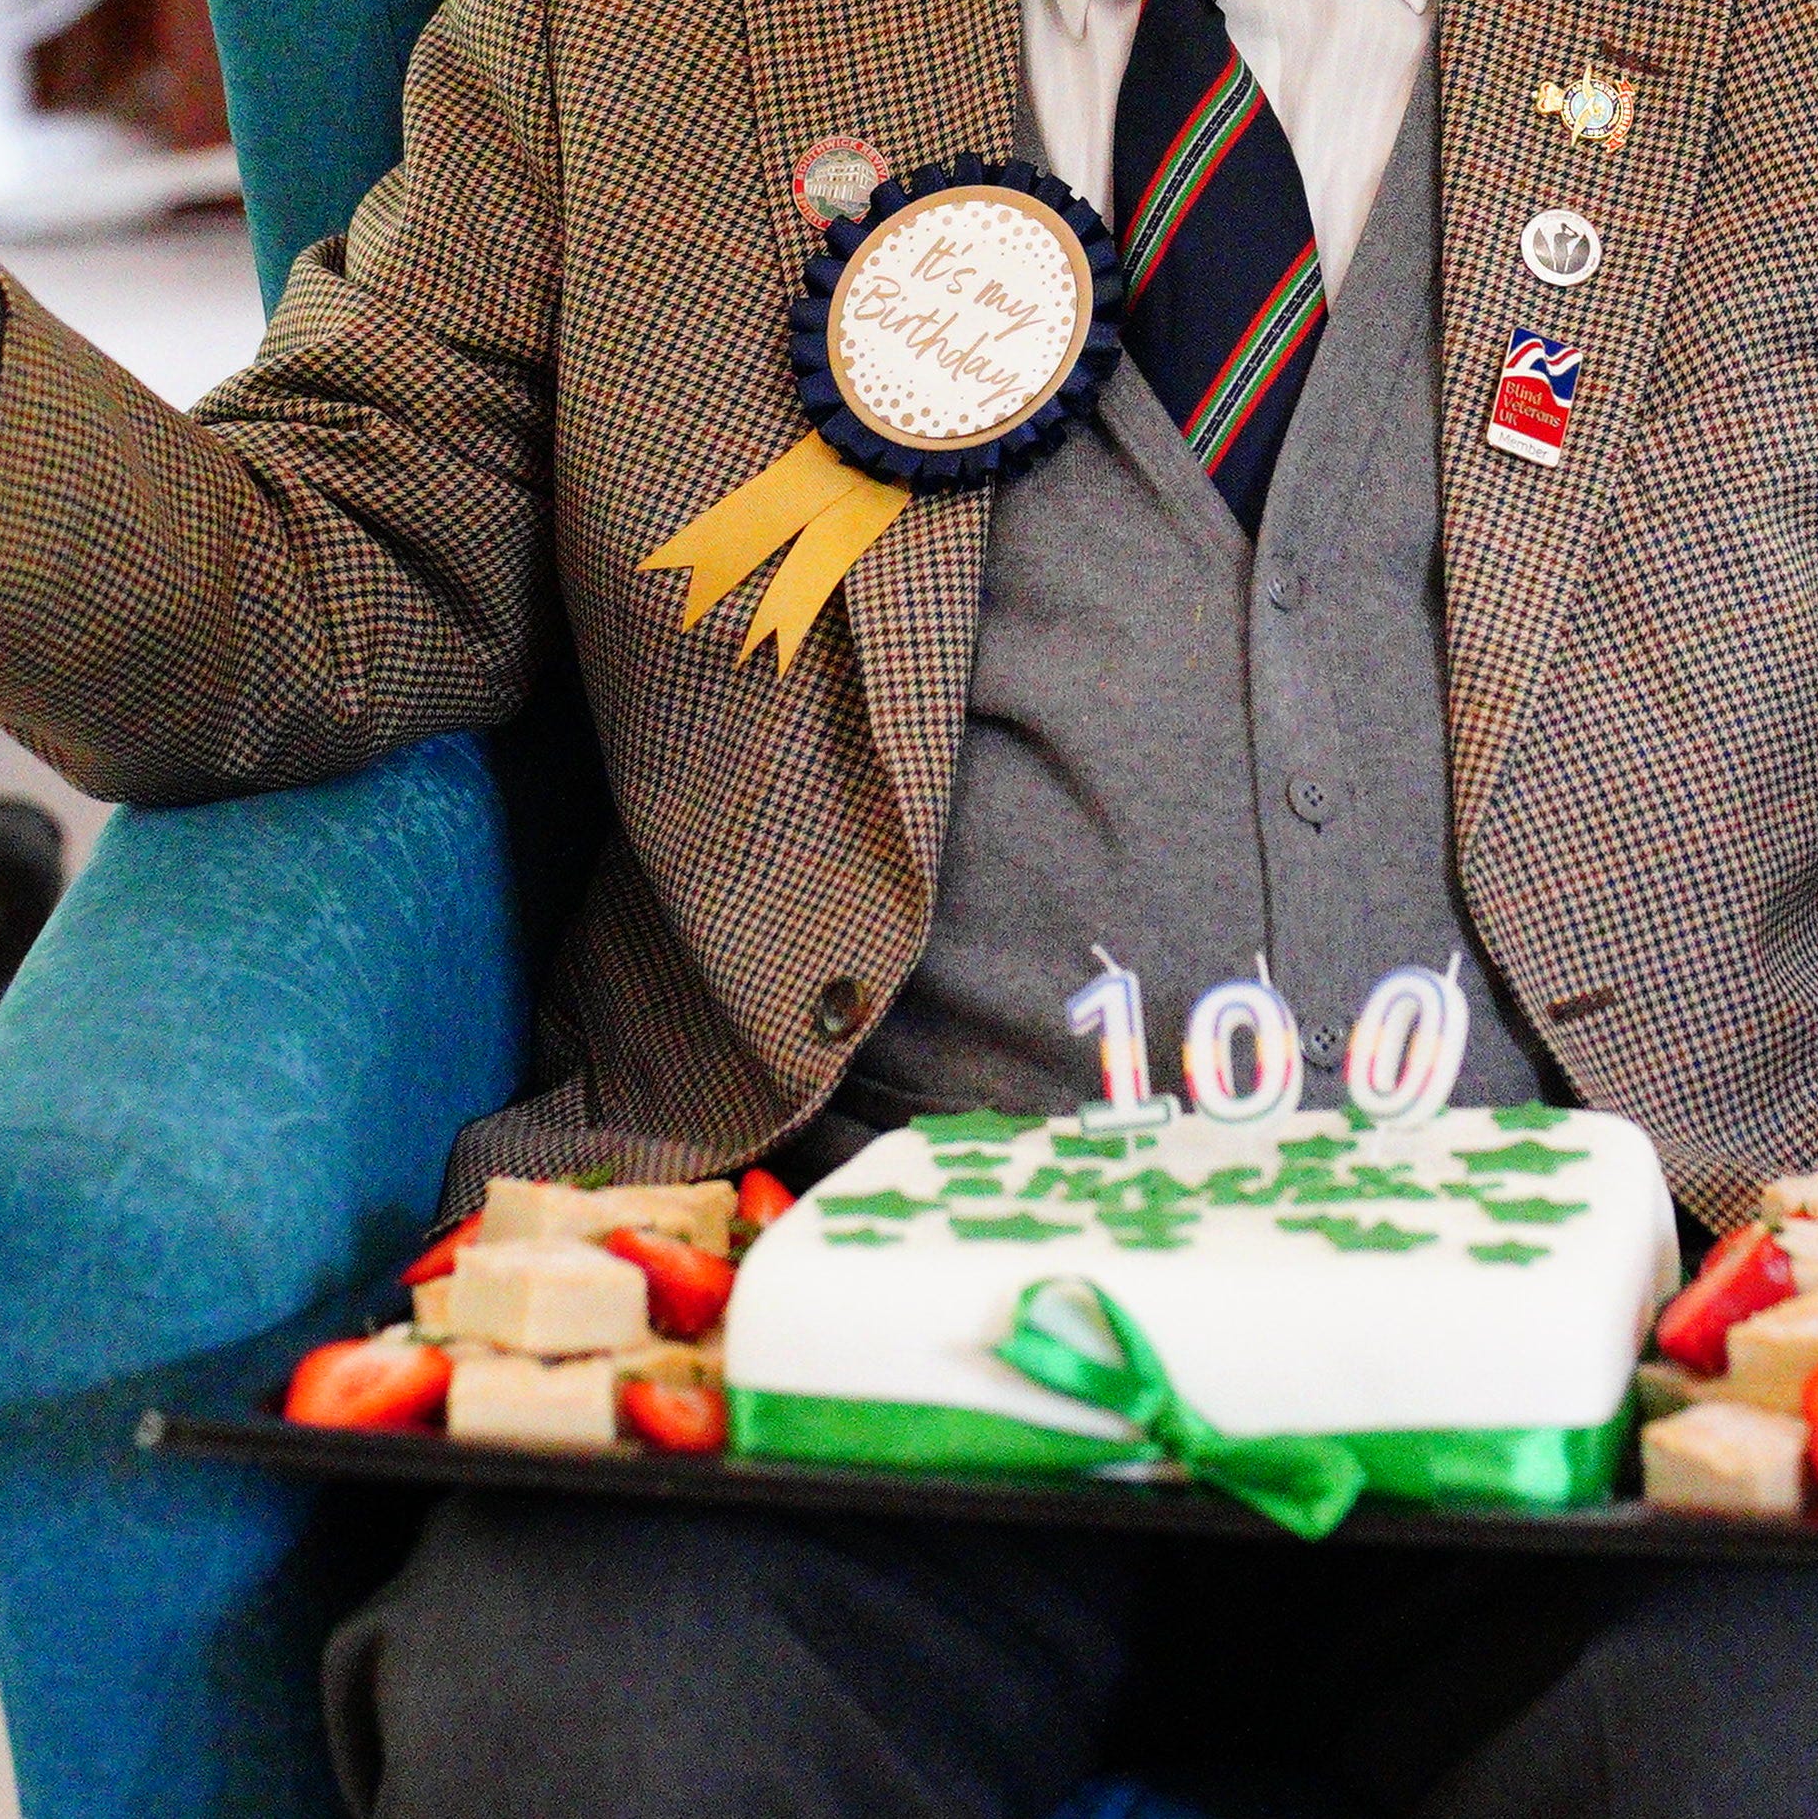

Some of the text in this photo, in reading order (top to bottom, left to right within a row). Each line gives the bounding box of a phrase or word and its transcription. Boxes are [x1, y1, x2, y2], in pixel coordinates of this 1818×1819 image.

[796, 139, 858, 179] SOUTHWICK
[909, 235, 1046, 342] It's my
[853, 274, 1027, 408] Birthday
[1502, 393, 1562, 429] Veterans
[1505, 380, 1543, 406] Blind
[1499, 408, 1518, 427] UK
[1498, 431, 1548, 459] Member
[1065, 962, 1471, 1136] 100
